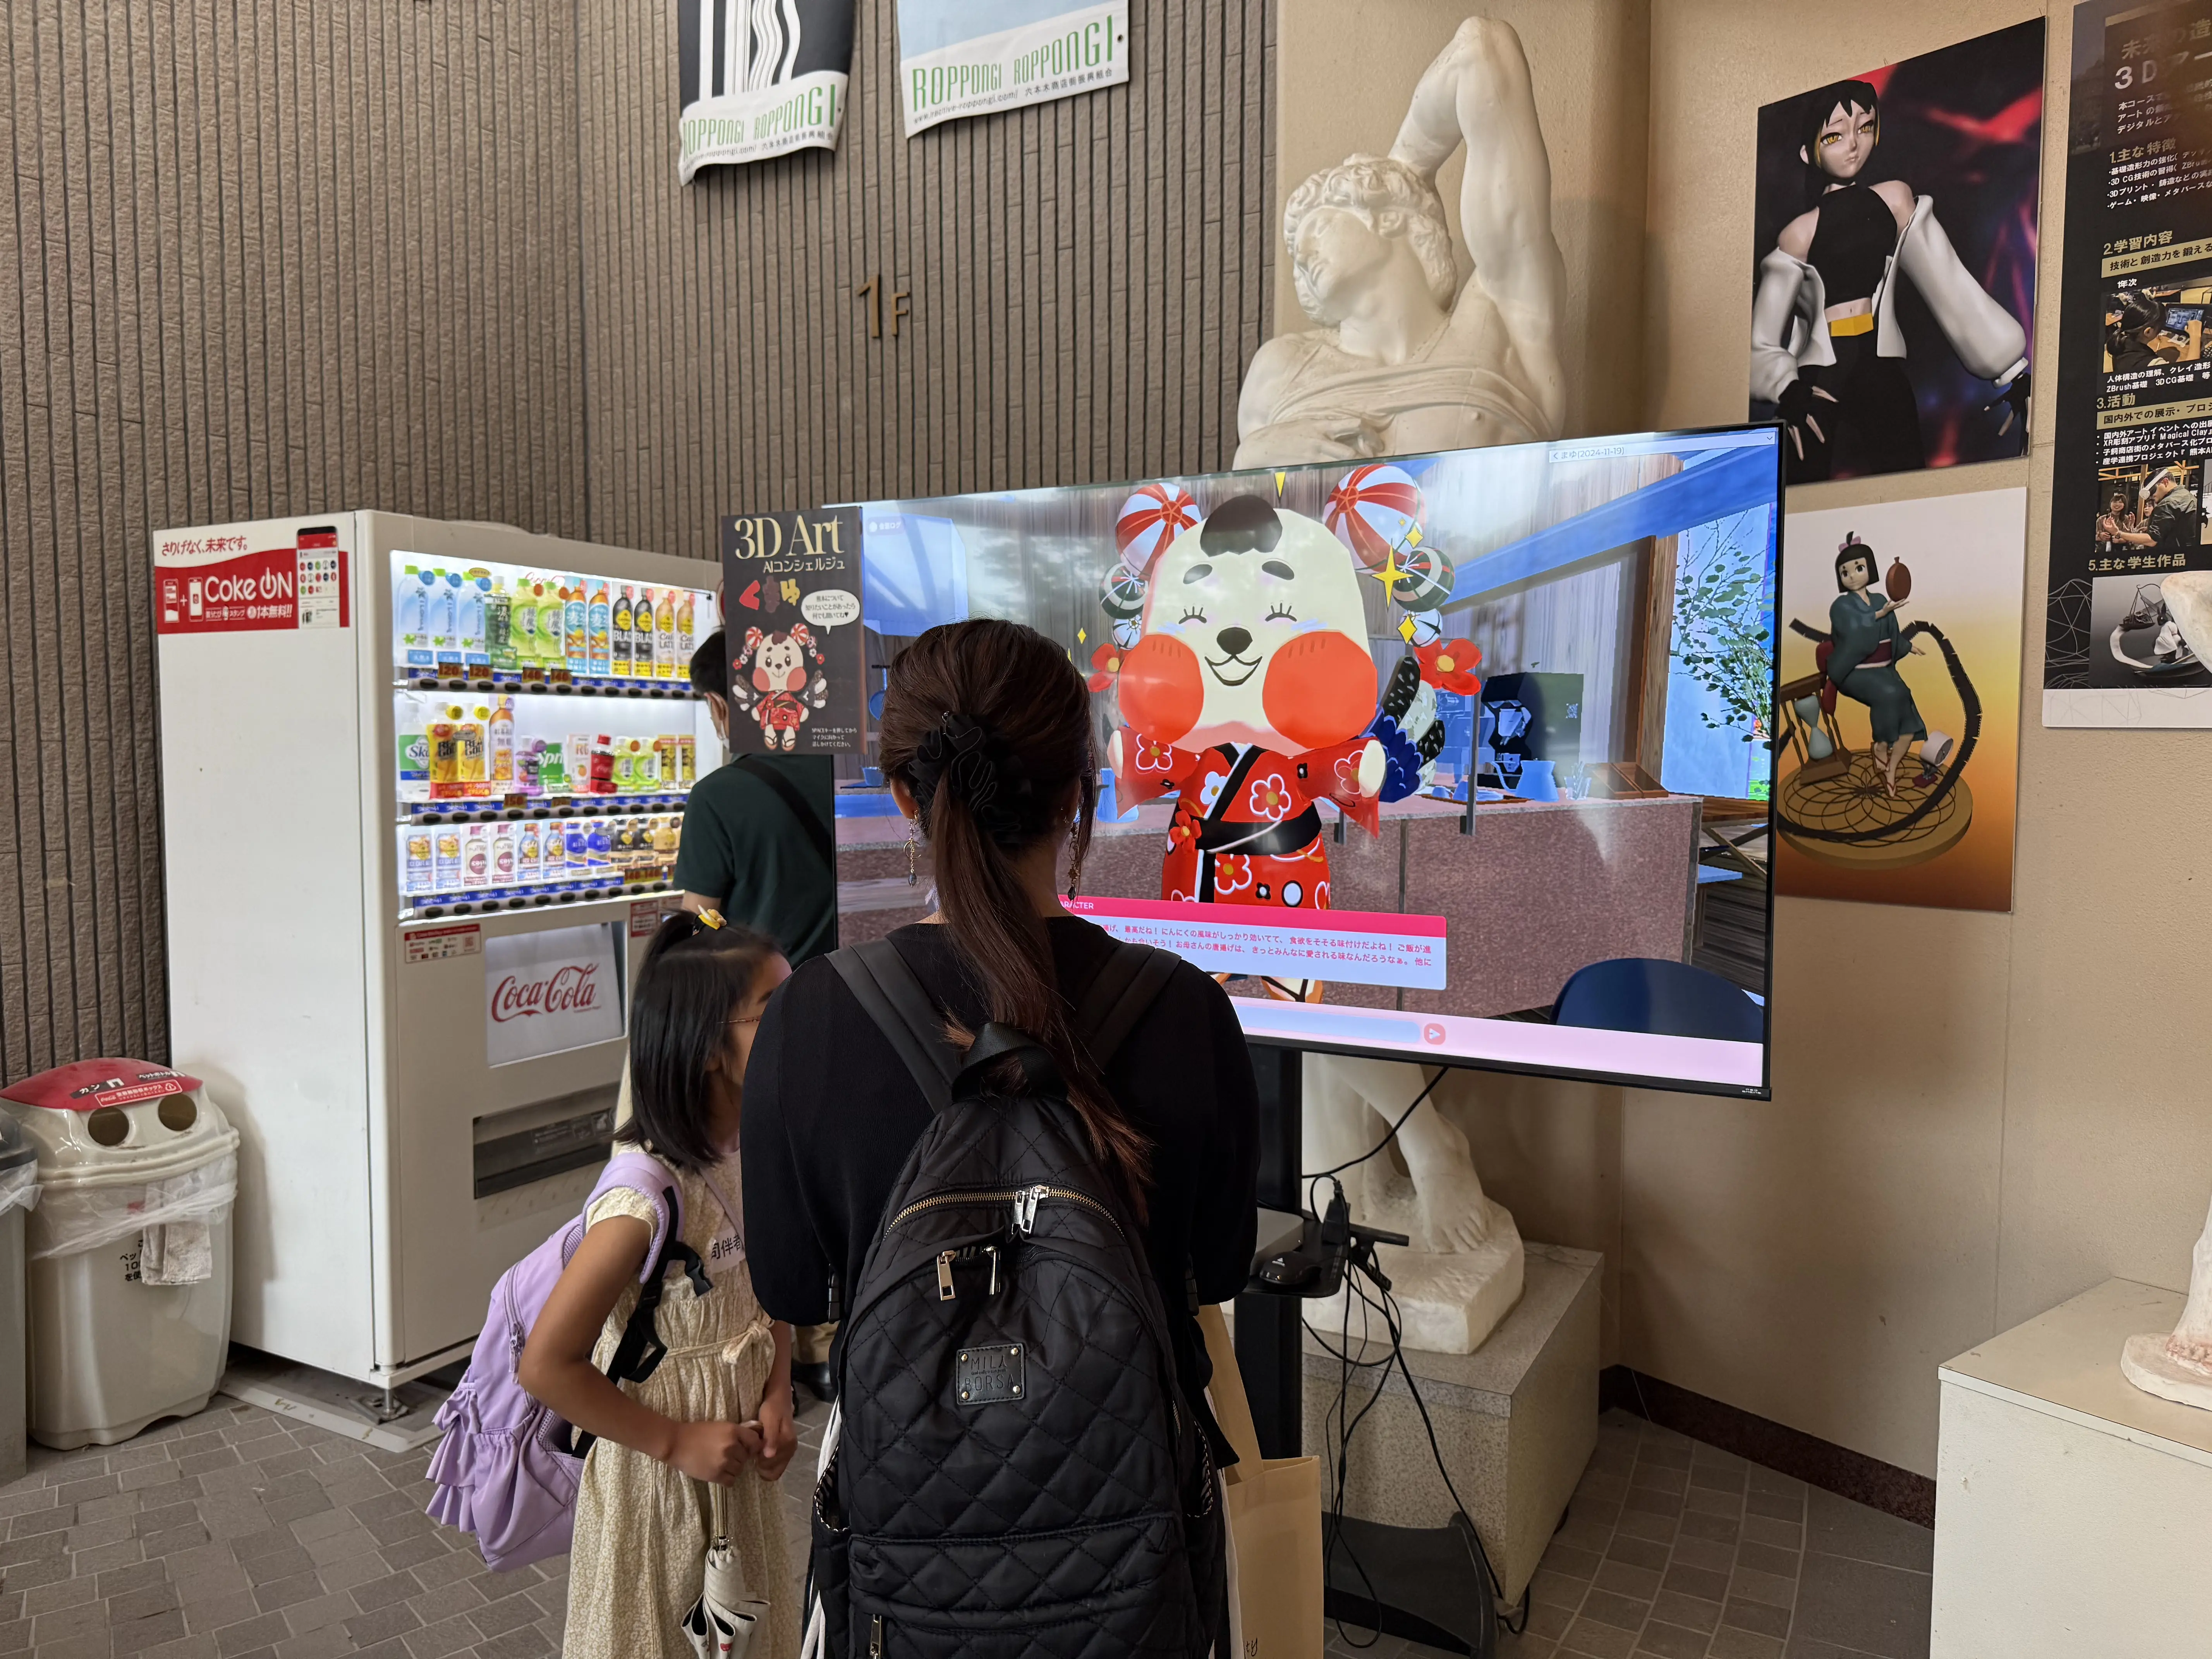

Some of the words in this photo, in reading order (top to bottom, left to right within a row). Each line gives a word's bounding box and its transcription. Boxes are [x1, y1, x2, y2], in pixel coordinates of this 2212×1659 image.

[913, 63, 1002, 112] ROPPONGI
[1014, 14, 1113, 85] ROPPONGI
[683, 118, 744, 162] ROPPONGI
[753, 84, 836, 140] ROPPONGI
[2109, 137, 2177, 164] 1.主な特徴
[2107, 361, 2211, 383] 人体構造の理解、クレイ造形
[2106, 380, 2148, 393] ZBrush基礎
[2096, 393, 2136, 409] 3.活動
[734, 517, 781, 559] 3D
[786, 514, 845, 556] Art
[161, 535, 248, 557] さりげなく、未来です。
[763, 556, 845, 574] AIコンシェルジュ
[2088, 553, 2186, 572] 5.主な学生作品
[205, 574, 257, 603] Coke
[259, 567, 292, 599] ON
[79, 1084, 100, 1094] カン
[120, 1249, 142, 1261] ペッ
[125, 1261, 141, 1272] 10
[971, 1355, 1008, 1370] MILA
[965, 1374, 1015, 1391] BORSA
